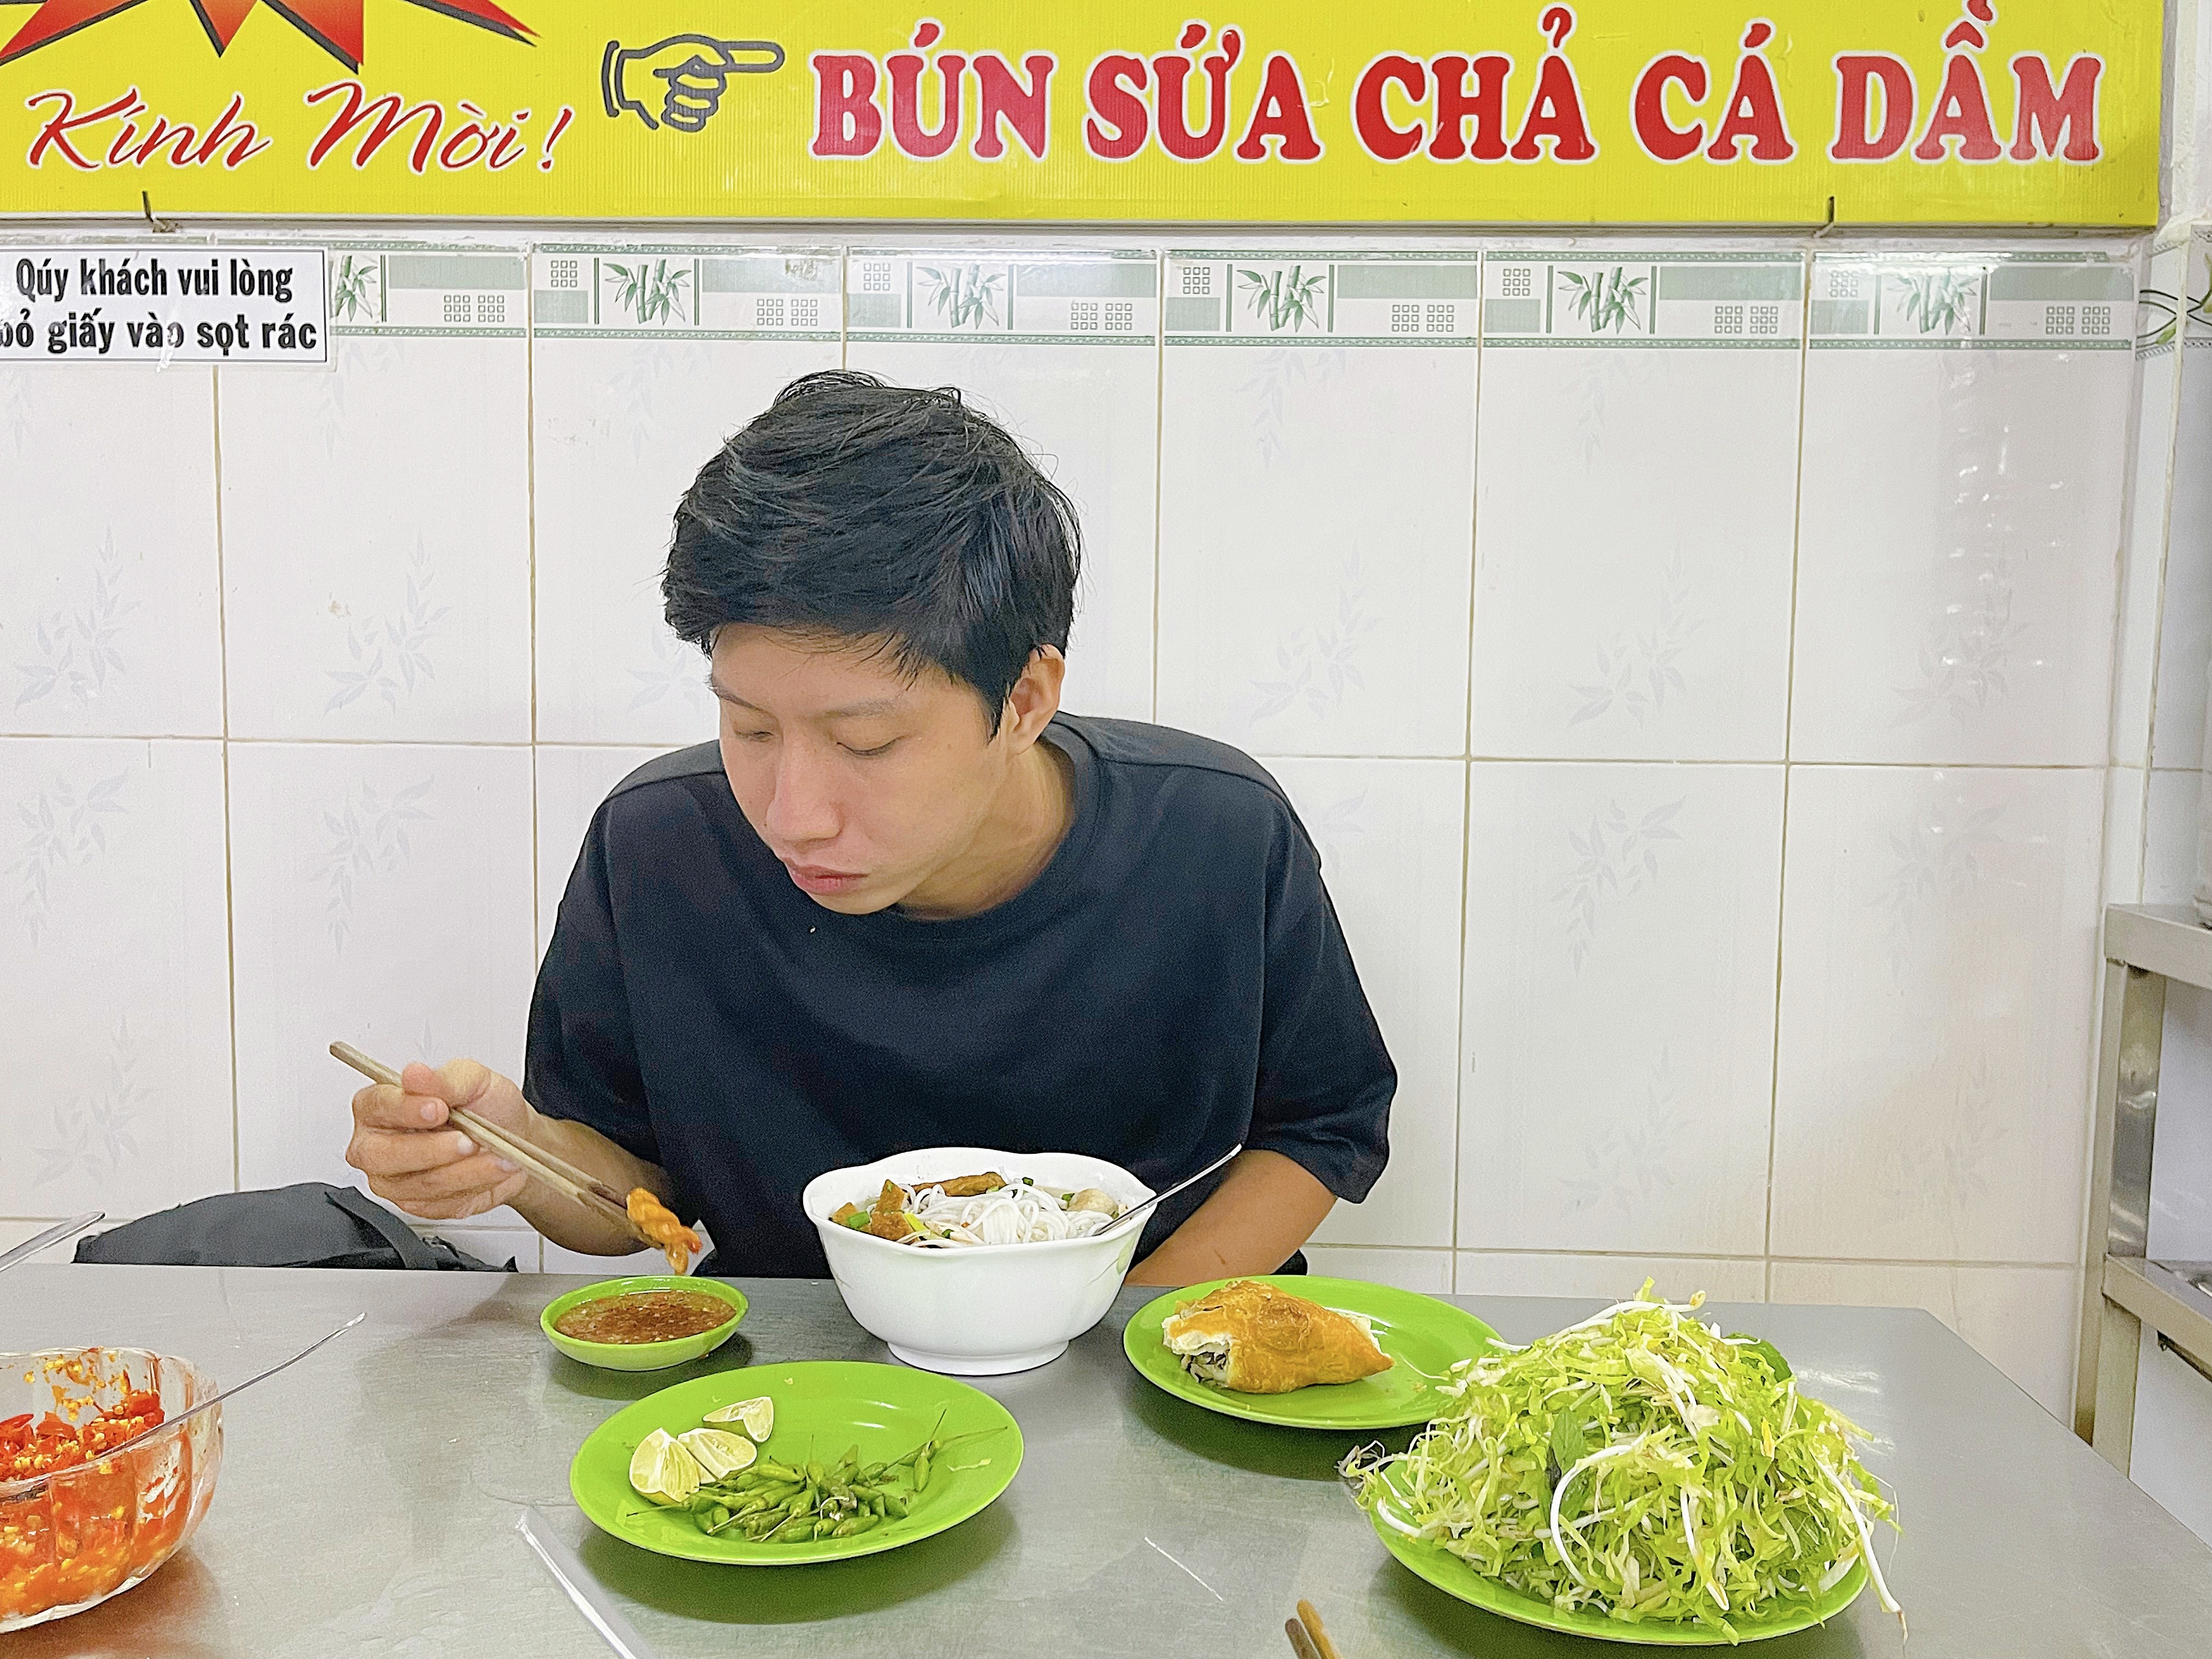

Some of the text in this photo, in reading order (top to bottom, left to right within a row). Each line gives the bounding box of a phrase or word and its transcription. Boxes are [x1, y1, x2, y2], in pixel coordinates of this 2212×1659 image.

[812, 0, 2102, 161] BÚN SỨA CHẢ CÁ DẦM
[28, 90, 273, 171] Kính
[16, 257, 294, 303] Qúy khách vui lòng
[48, 307, 115, 354] giấy
[126, 311, 184, 348] vào
[197, 314, 250, 357] sọt
[262, 312, 317, 349] rác
